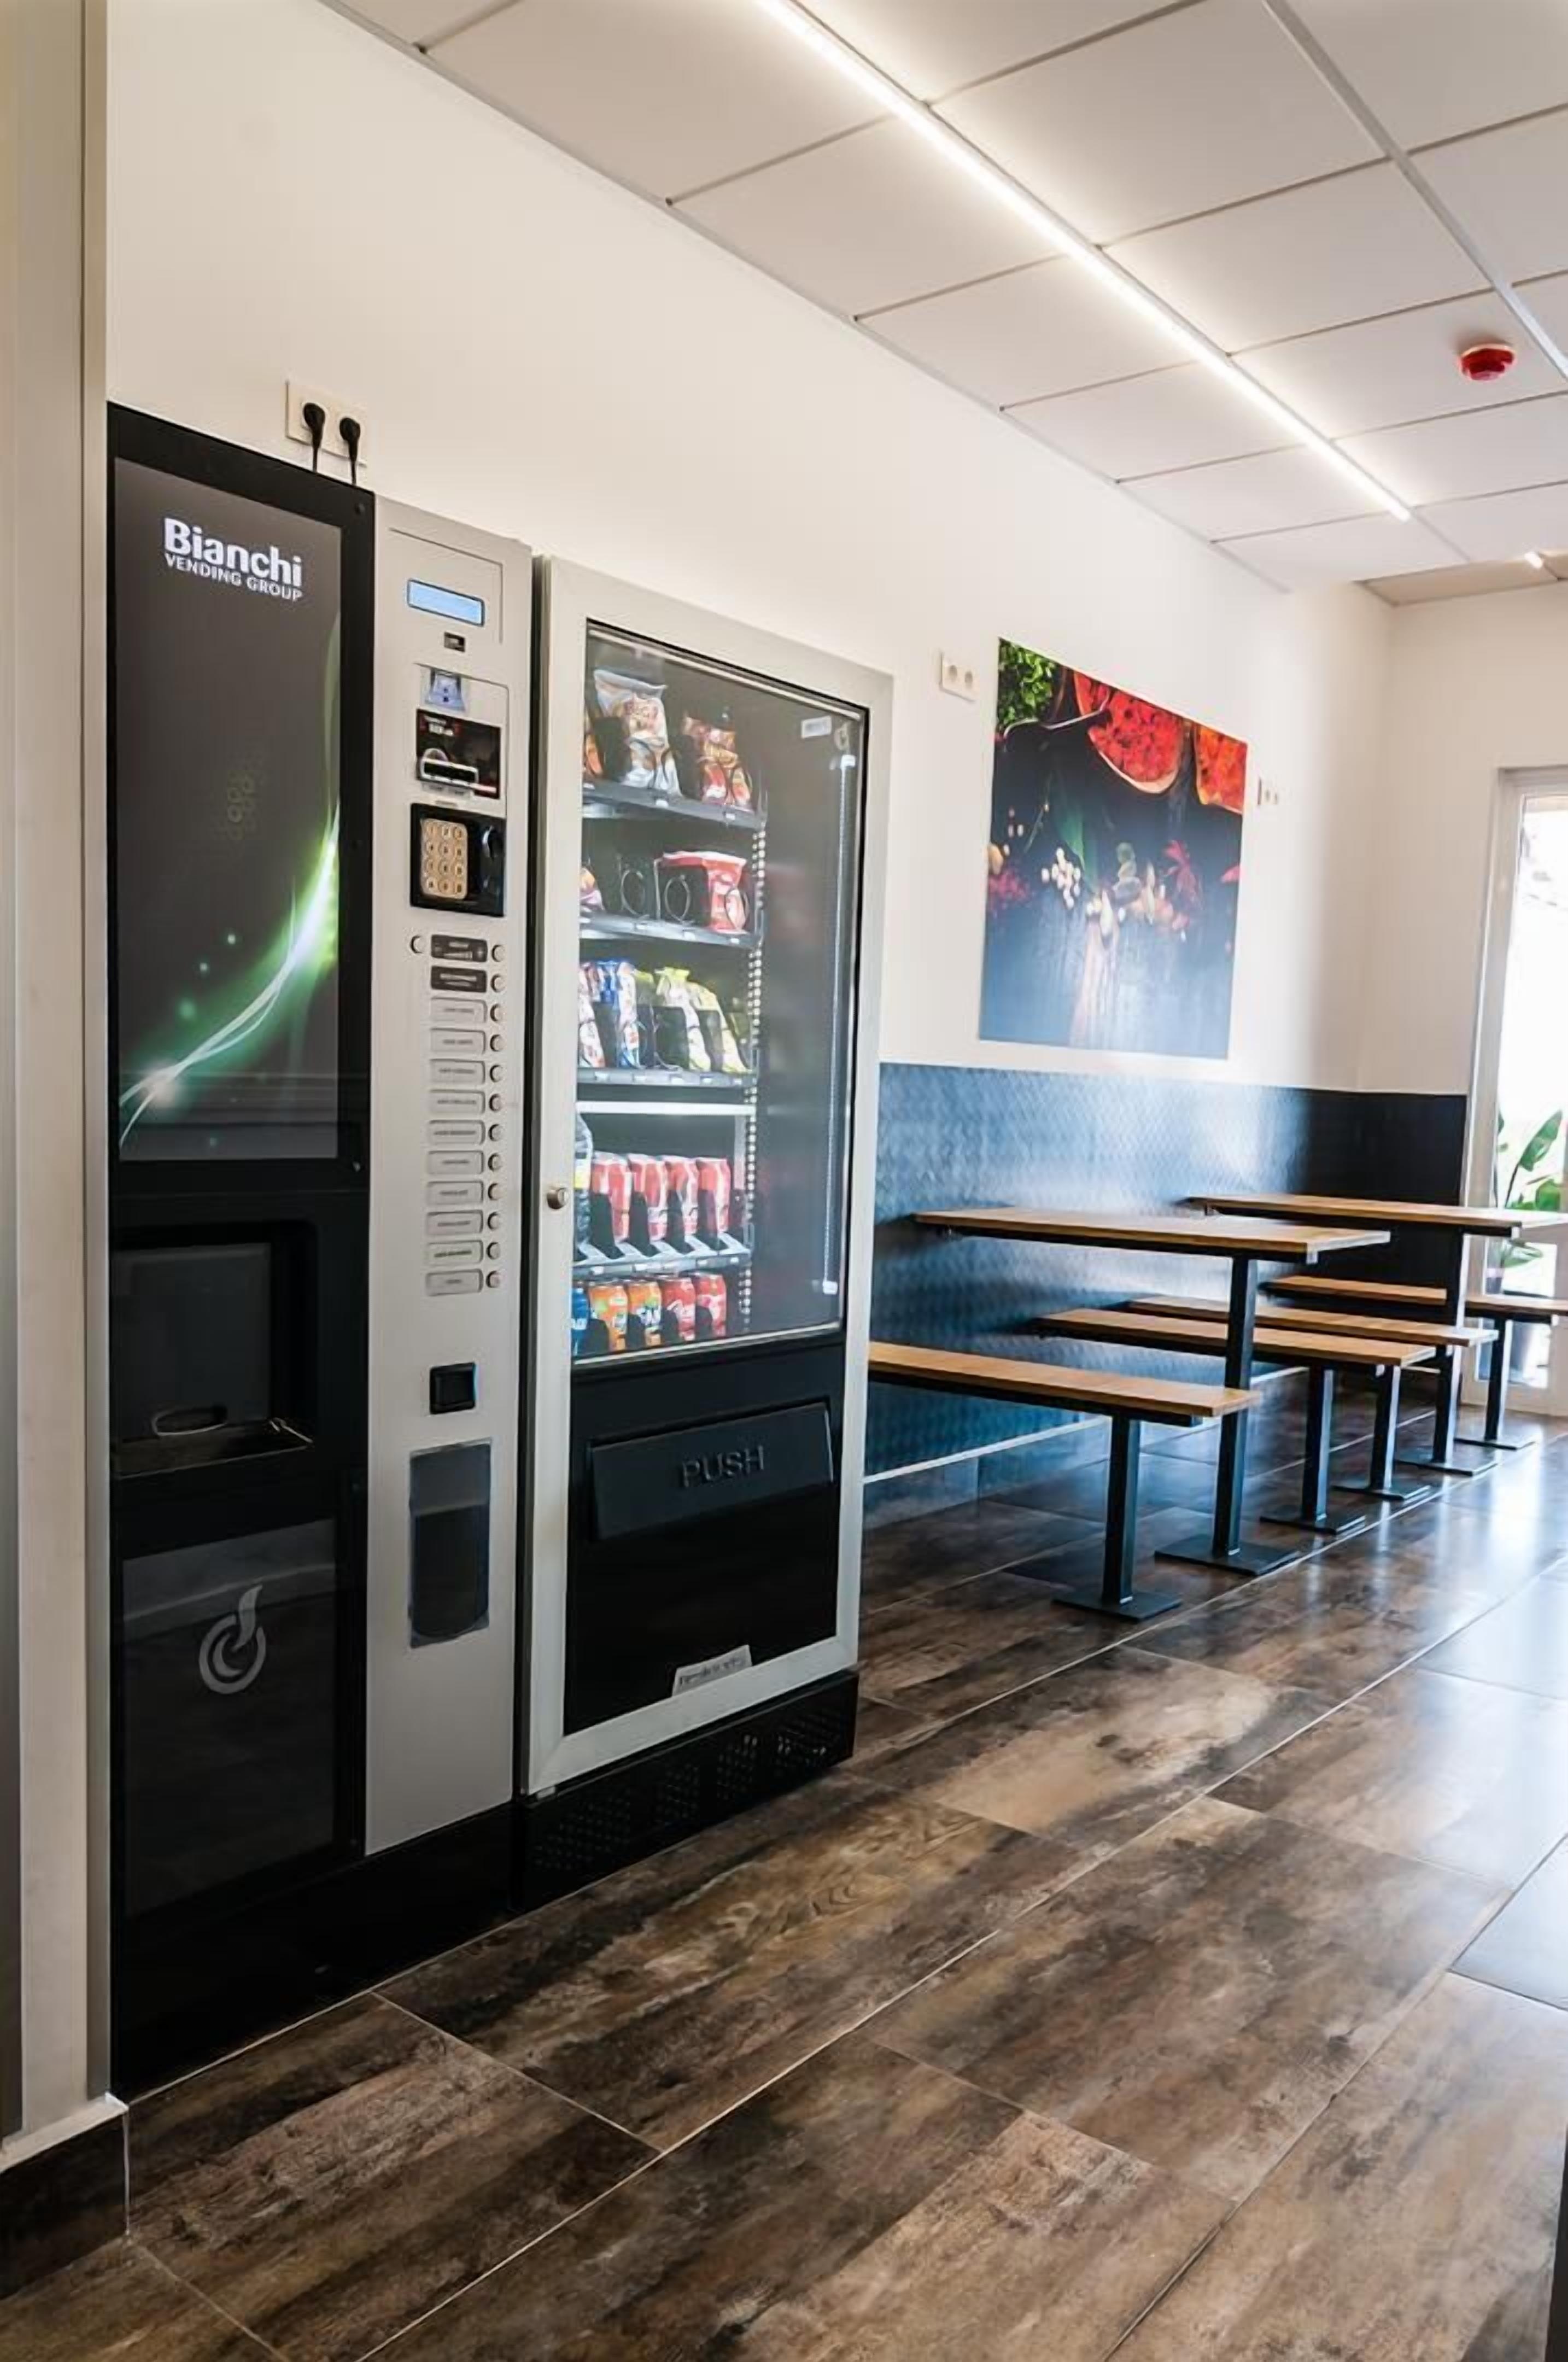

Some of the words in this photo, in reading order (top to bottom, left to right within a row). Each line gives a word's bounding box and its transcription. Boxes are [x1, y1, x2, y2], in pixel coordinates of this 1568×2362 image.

[165, 518, 301, 587] Bianchi
[165, 552, 242, 586] VENDING
[247, 576, 302, 601] GROUP
[683, 1445, 764, 1487] PUSH
